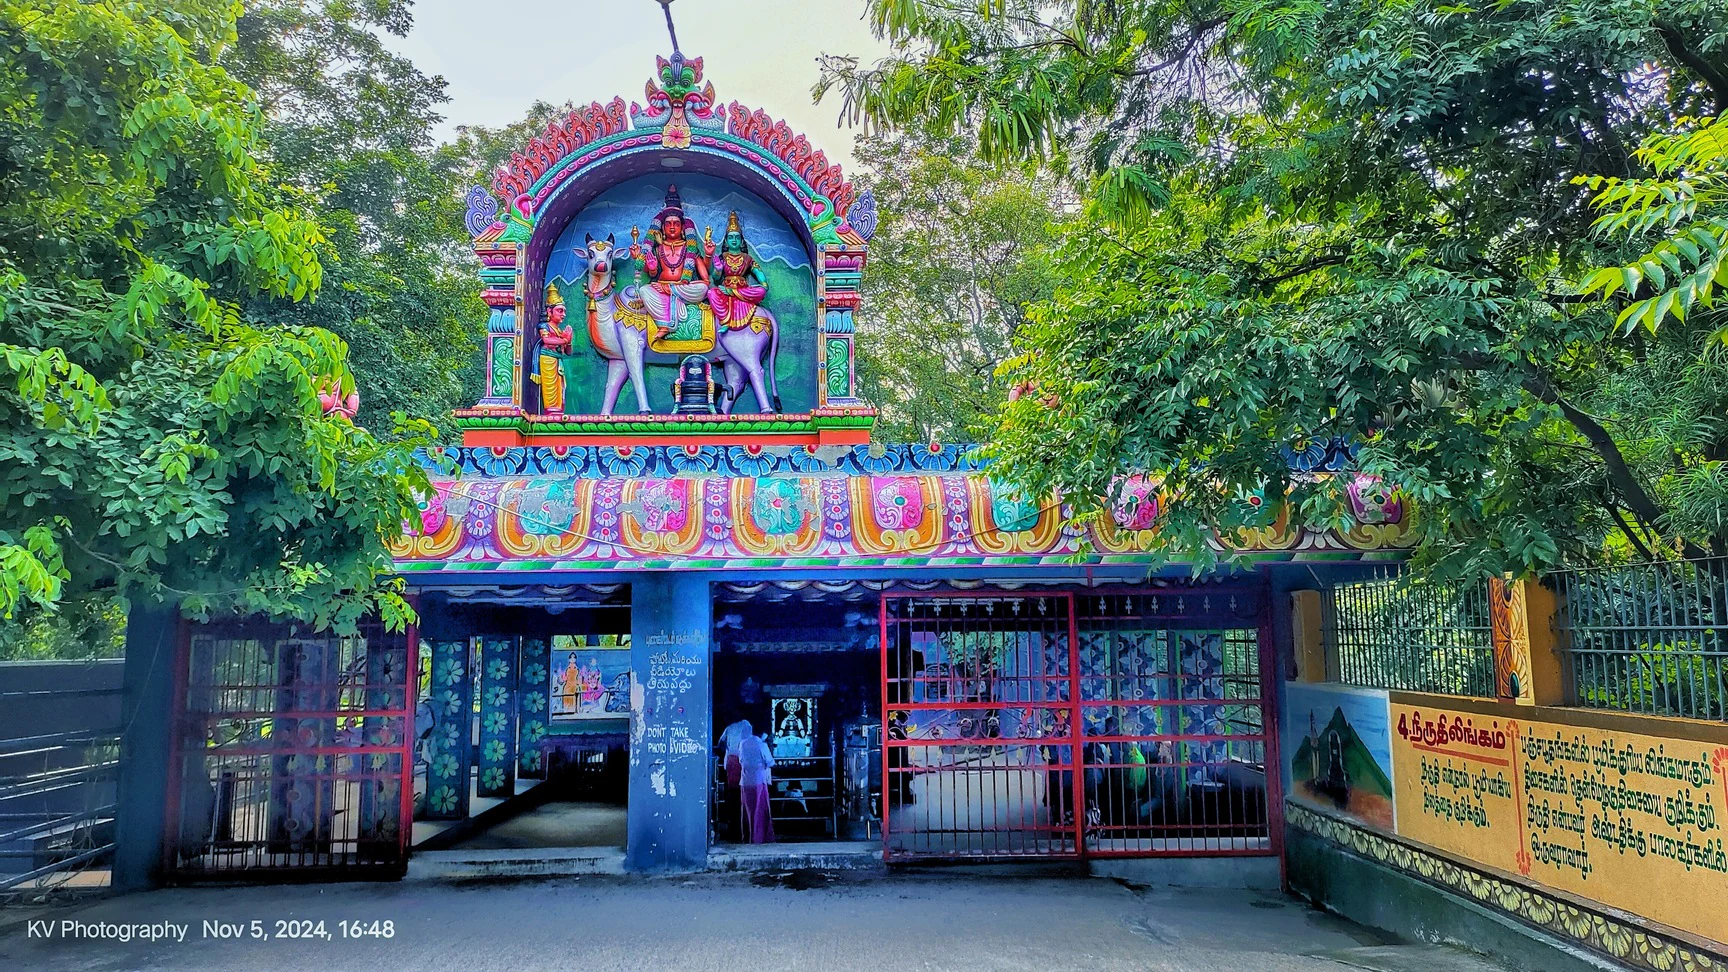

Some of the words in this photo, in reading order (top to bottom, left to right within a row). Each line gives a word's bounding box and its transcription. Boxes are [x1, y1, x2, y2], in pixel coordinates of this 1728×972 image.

[670, 727, 689, 738] TAKE
[647, 742, 667, 754] PHOTO
[1524, 761, 1568, 795] திசைகளில்
[1527, 794, 1550, 834] நிருதி
[1552, 800, 1585, 840] என்பவர்
